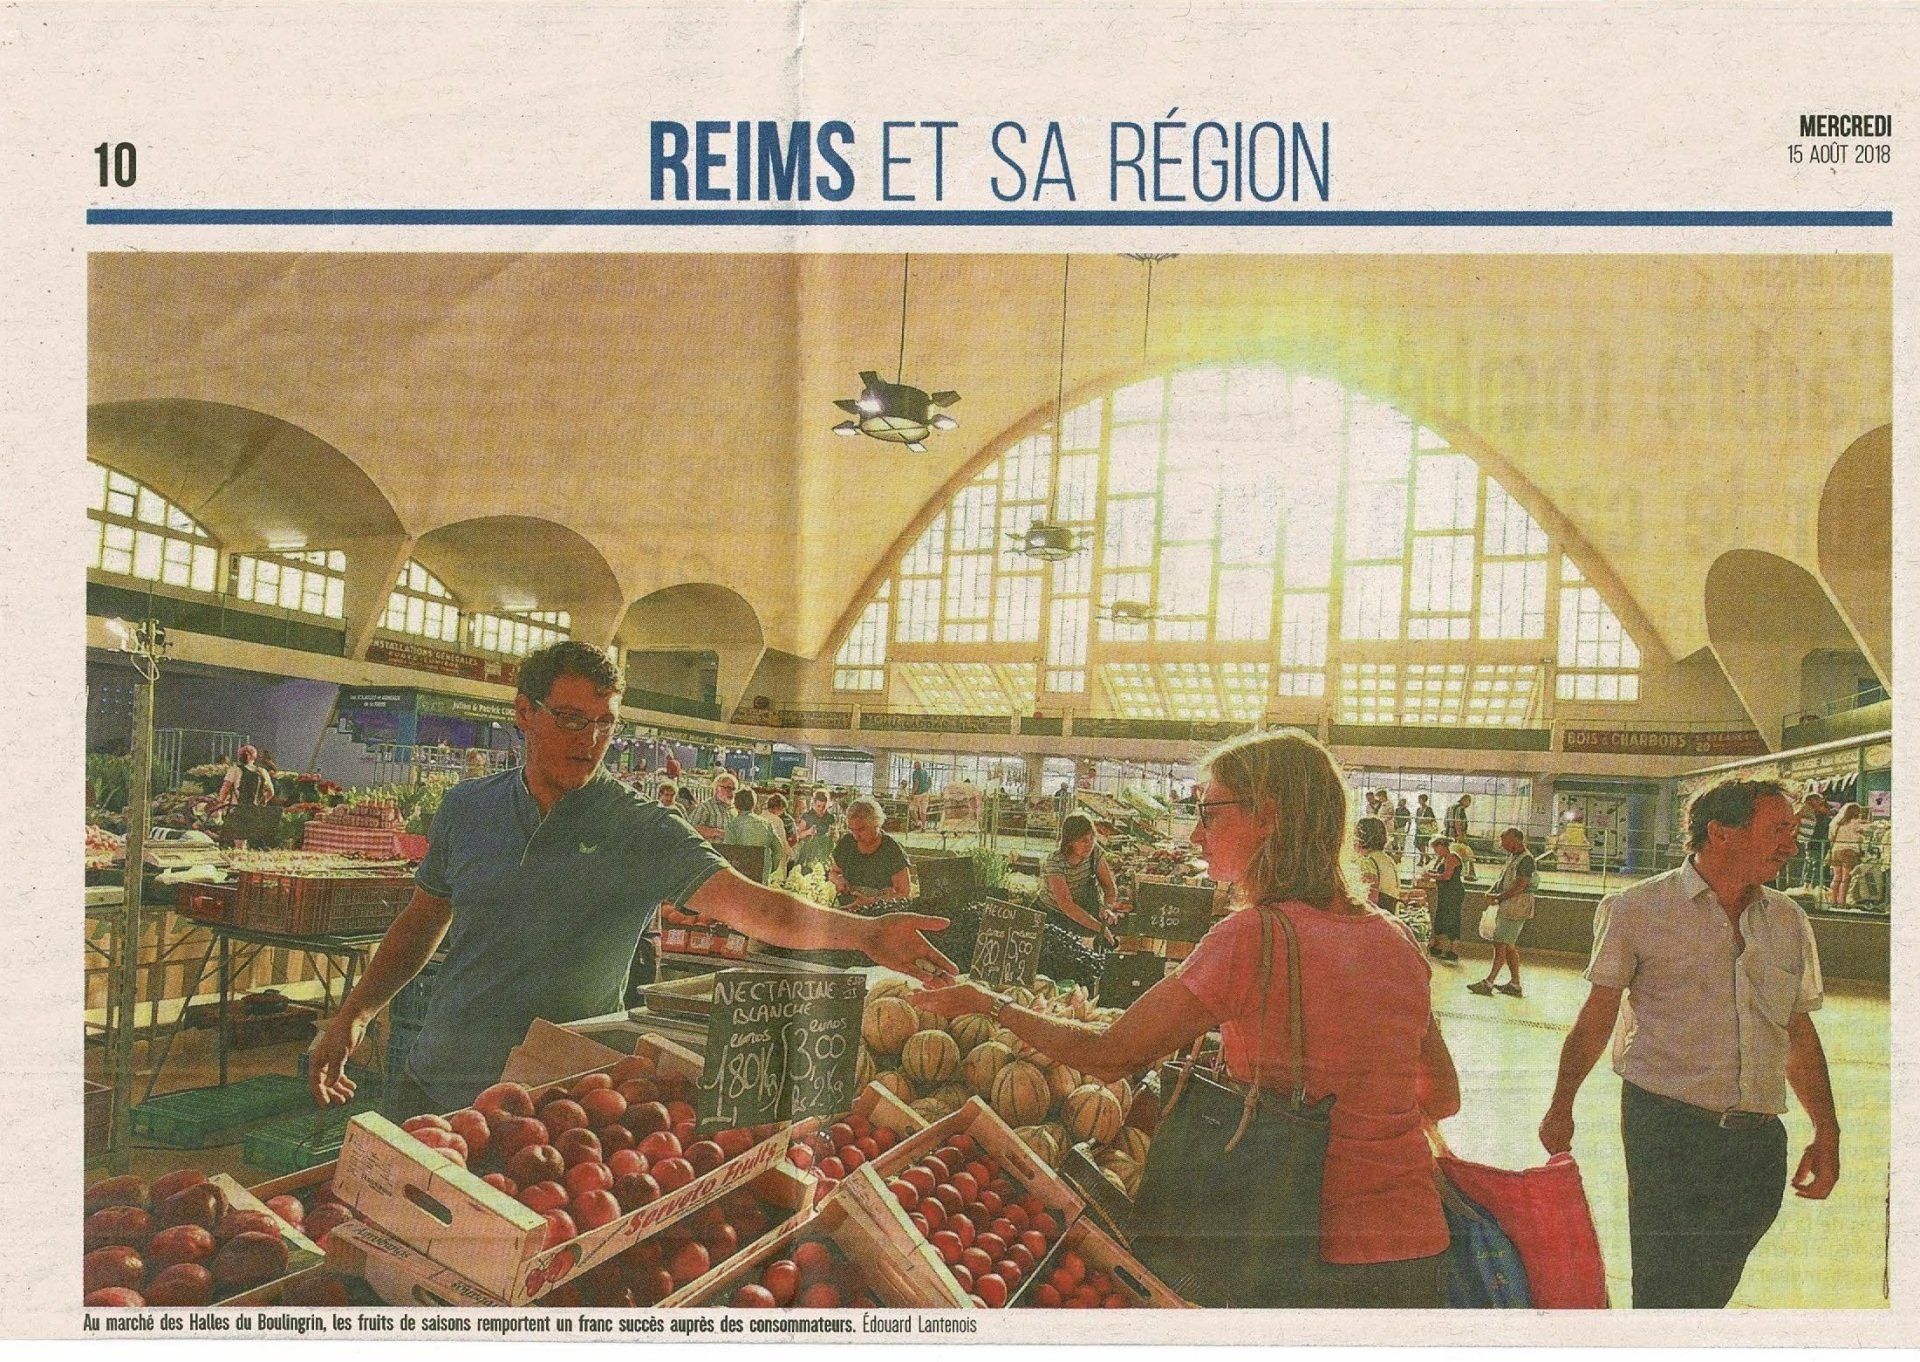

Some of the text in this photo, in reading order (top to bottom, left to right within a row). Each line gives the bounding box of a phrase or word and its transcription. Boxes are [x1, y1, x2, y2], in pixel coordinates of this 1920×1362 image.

[1800, 114, 1892, 137] MERCREDI
[650, 106, 1330, 202] REIMS ET SA RÉGION
[1787, 140, 1891, 164] 15 AOÛT 2018
[94, 141, 137, 188] 10
[1567, 732, 1598, 746] BOIS
[1611, 733, 1687, 749] CHARBONS
[713, 979, 837, 1006] NECTARINE
[732, 1001, 814, 1025] BLANCHE
[83, 1312, 977, 1337] Au marché des Halles du Boulingrin, les fruits de saisons remportent un franc succès auprès des consommateurs. Édouard Lantenois
